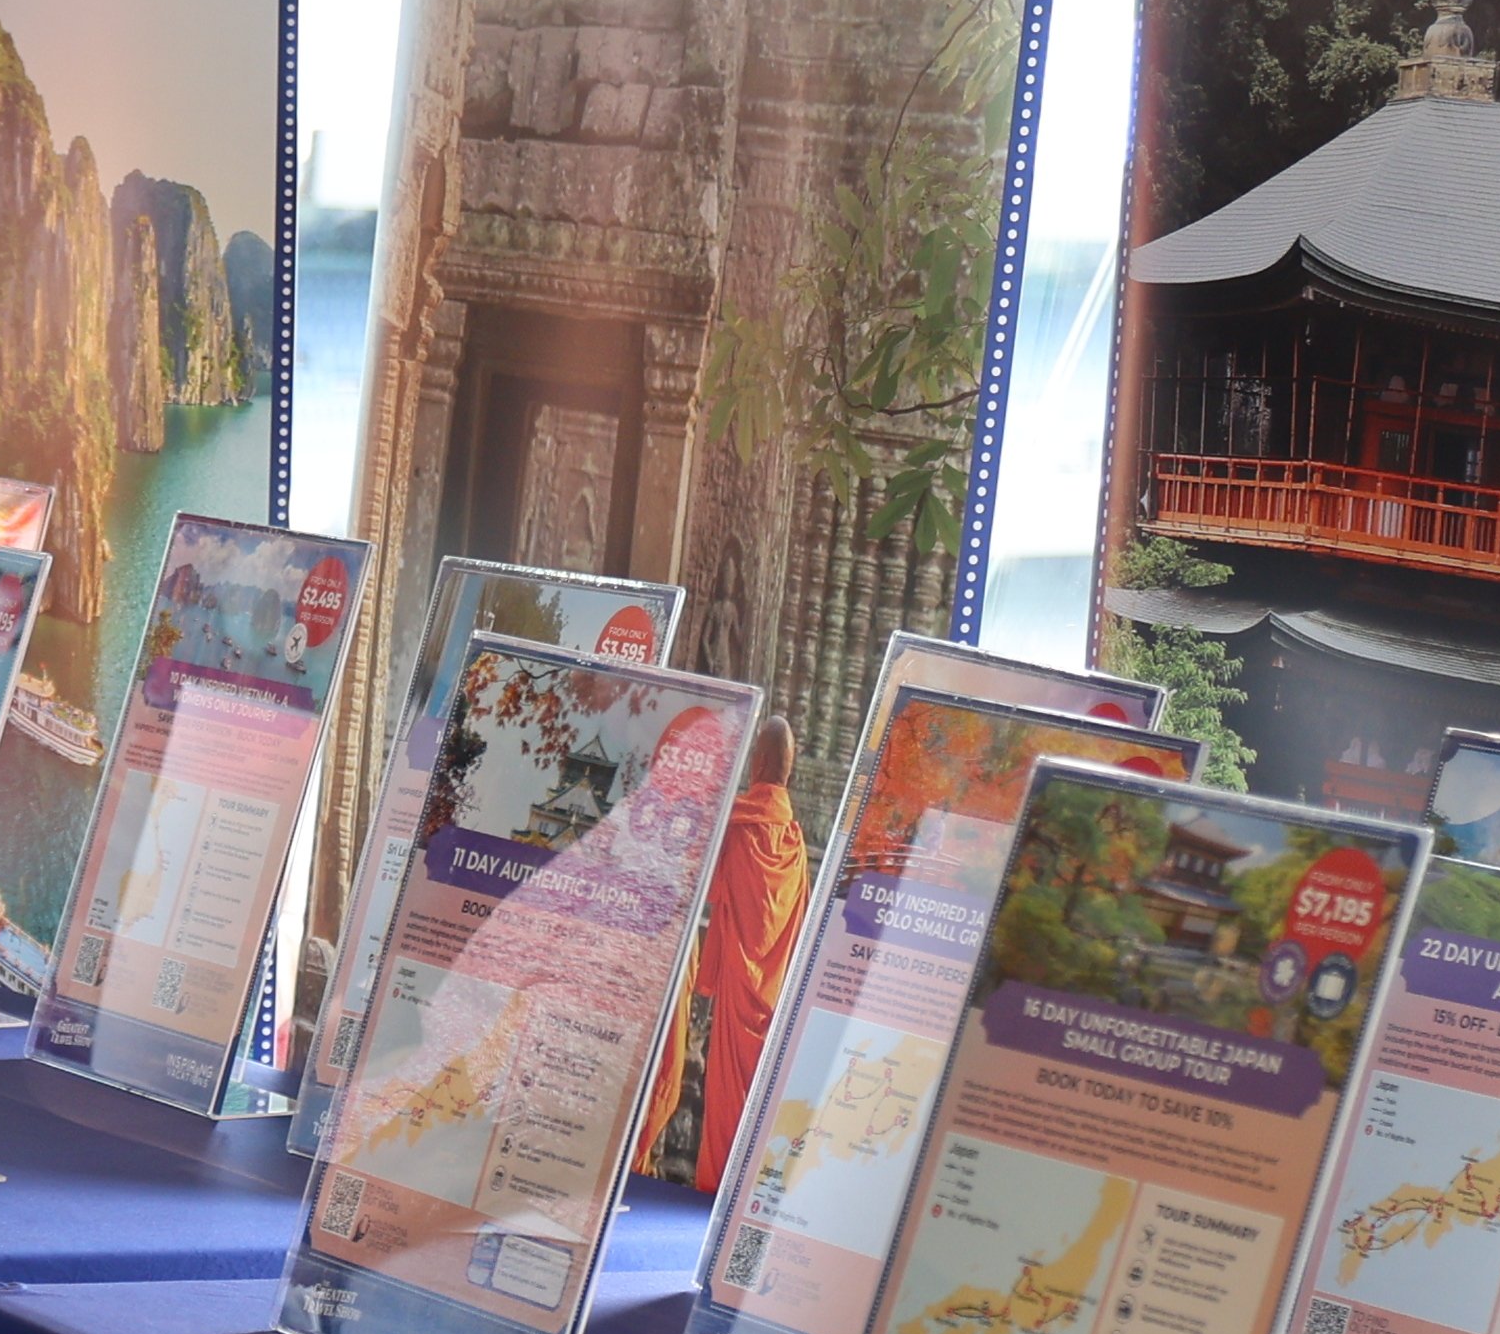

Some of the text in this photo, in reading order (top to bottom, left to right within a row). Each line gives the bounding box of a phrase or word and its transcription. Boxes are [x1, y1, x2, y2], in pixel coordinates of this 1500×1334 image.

[302, 587, 342, 610] $2,495
[600, 637, 647, 662] $3,595
[608, 625, 648, 640] FROM ONLY
[169, 671, 289, 708] 10 DAY INSPIRED VIETNAM A
[213, 696, 237, 714] ONLY
[237, 701, 278, 723] JOURNEY
[218, 798, 269, 818] TOUR SUMMARY
[452, 846, 642, 912] 11 DAY AUTHENTIC JAPAN
[461, 899, 494, 917] BOOK
[860, 883, 874, 901] 15
[874, 887, 904, 908] DAY
[905, 893, 967, 923] INSPIRED
[1295, 886, 1374, 927] $7,195
[874, 909, 980, 948] SOLO SMALL GR
[850, 943, 881, 963] SAVE
[911, 957, 936, 977] PER
[1419, 938, 1443, 959] 22
[1444, 942, 1483, 968] DAY
[1023, 998, 1283, 1075] 16 DAY UNFORGETTABLE JAPAN
[1433, 1008, 1457, 1027] 15%
[1459, 1013, 1487, 1033] OFF
[1062, 1029, 1232, 1086] SMALL GROUP TOUR
[1036, 1068, 1080, 1093] BOOK
[1083, 1078, 1137, 1105] TODAY
[1138, 1092, 1160, 1112] TO
[1161, 1098, 1204, 1123] SAVE
[1156, 1202, 1262, 1244] TOUR SUMMARY
[312, 1283, 358, 1304] GREATEST
